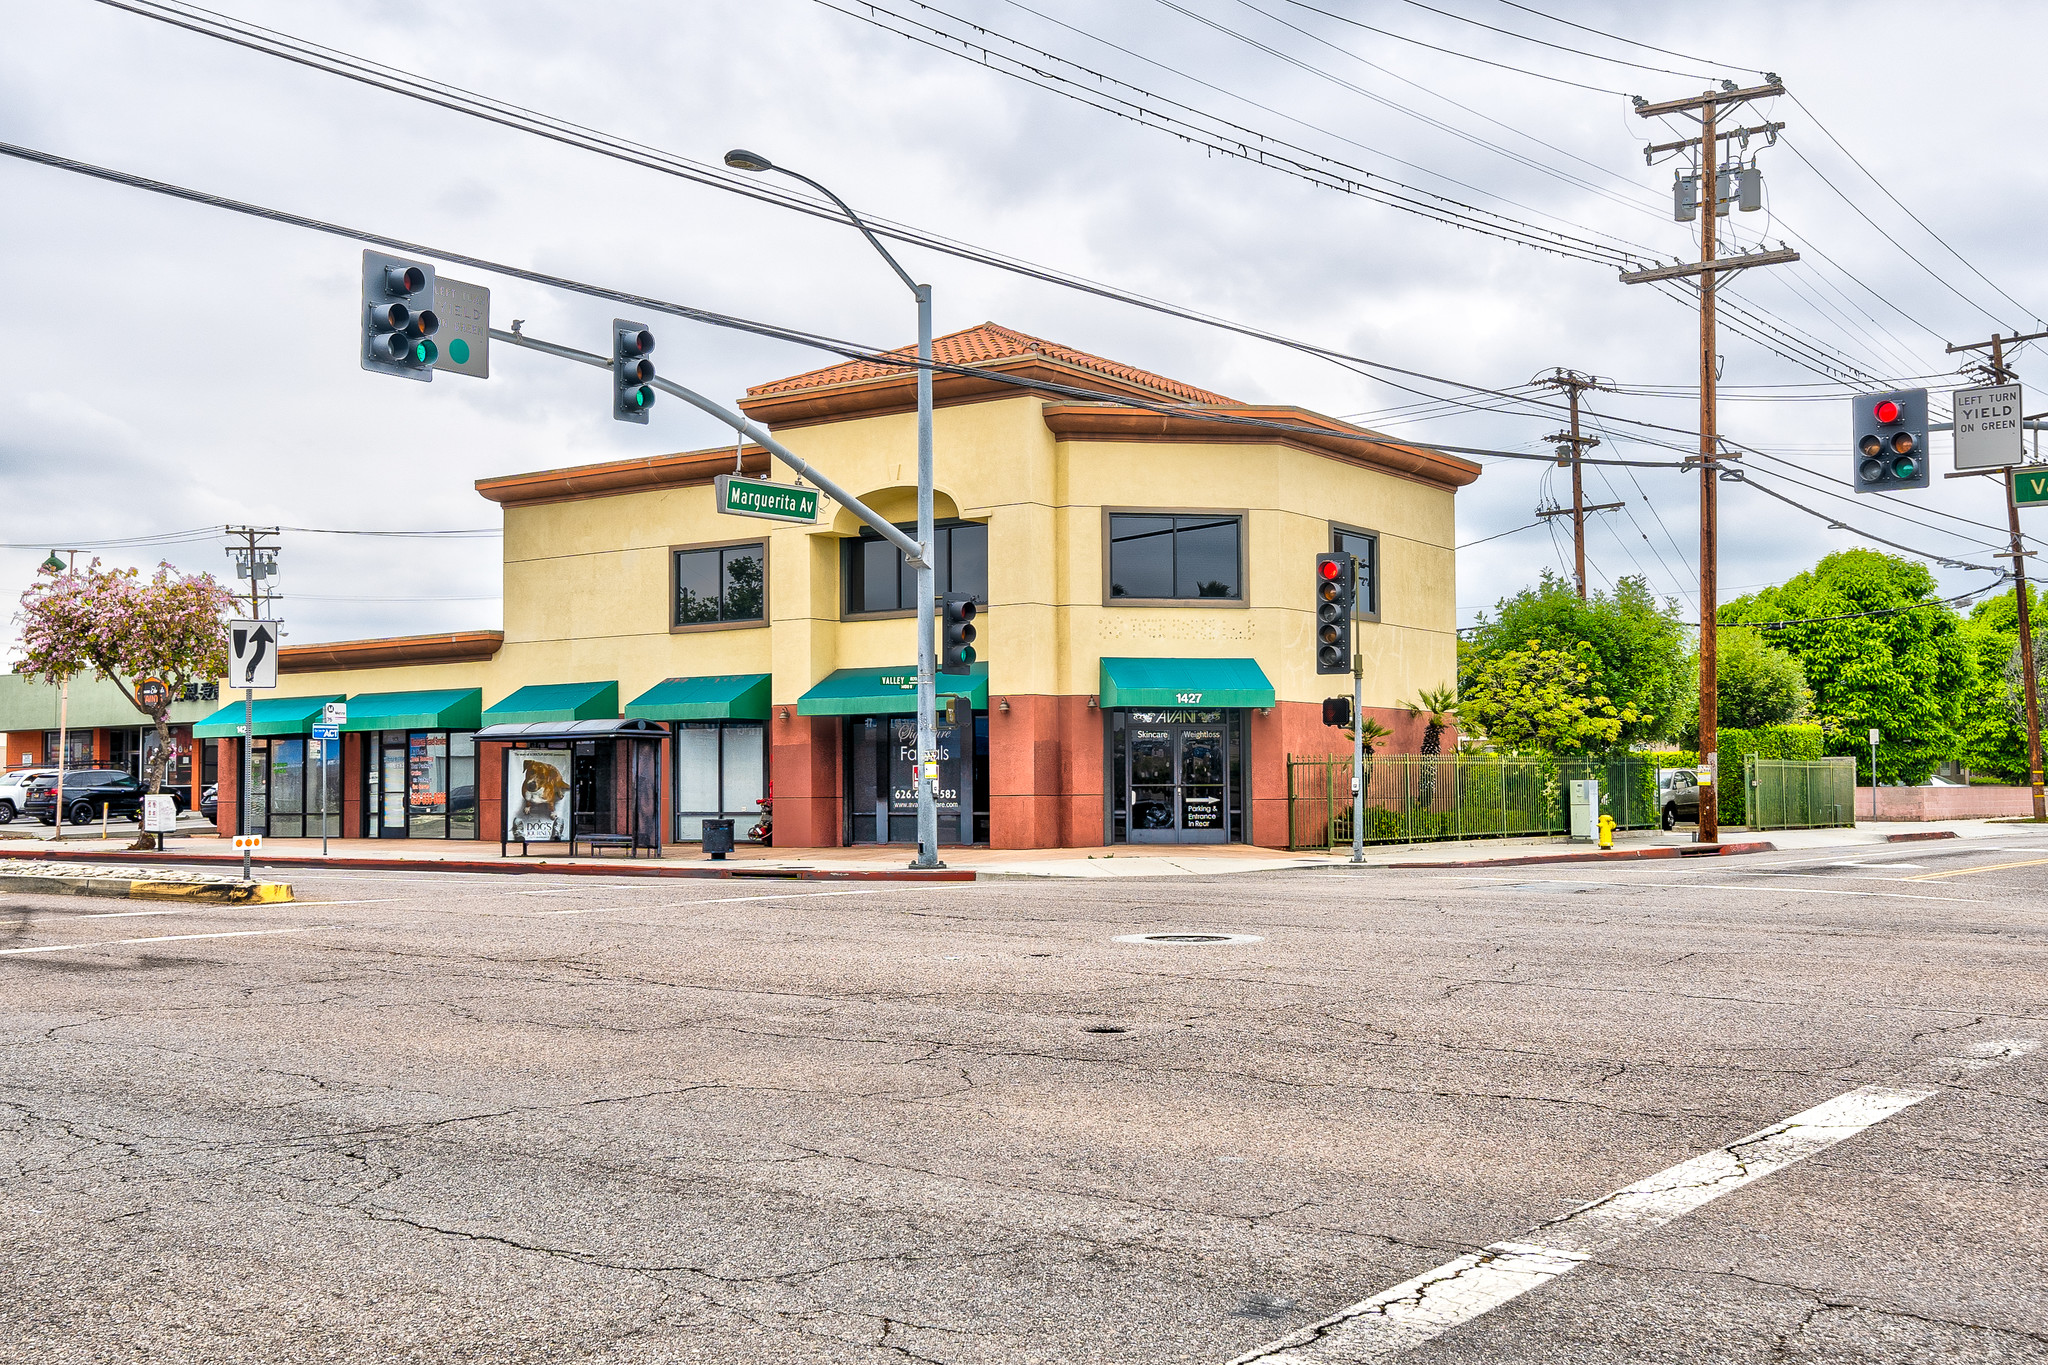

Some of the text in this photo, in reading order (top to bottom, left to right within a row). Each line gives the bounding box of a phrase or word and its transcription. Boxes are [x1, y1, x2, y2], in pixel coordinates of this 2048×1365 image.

[435, 285, 456, 298] LEFT
[440, 301, 482, 319] YIELD
[454, 321, 484, 336] GREEN
[1958, 392, 2017, 406] LEFT TURN
[1962, 405, 2013, 420] YIELD
[1960, 419, 2016, 433] ON GREEN
[2030, 478, 2048, 495] V
[731, 487, 814, 513] Marguerita Av
[881, 676, 905, 685] VALLEY
[1175, 693, 1203, 704] 1427
[1156, 710, 1197, 723] AVANT
[236, 725, 248, 734] 142
[323, 729, 338, 738] ACT
[898, 724, 952, 747] Sigure
[1137, 730, 1169, 738] Skincare
[1183, 730, 1221, 740] Weightloss
[900, 745, 950, 761] Fals
[895, 789, 957, 799] 626.6582
[893, 801, 959, 810] www.avaare.com
[1188, 805, 1211, 813] Parking
[526, 822, 552, 831] DOG'S
